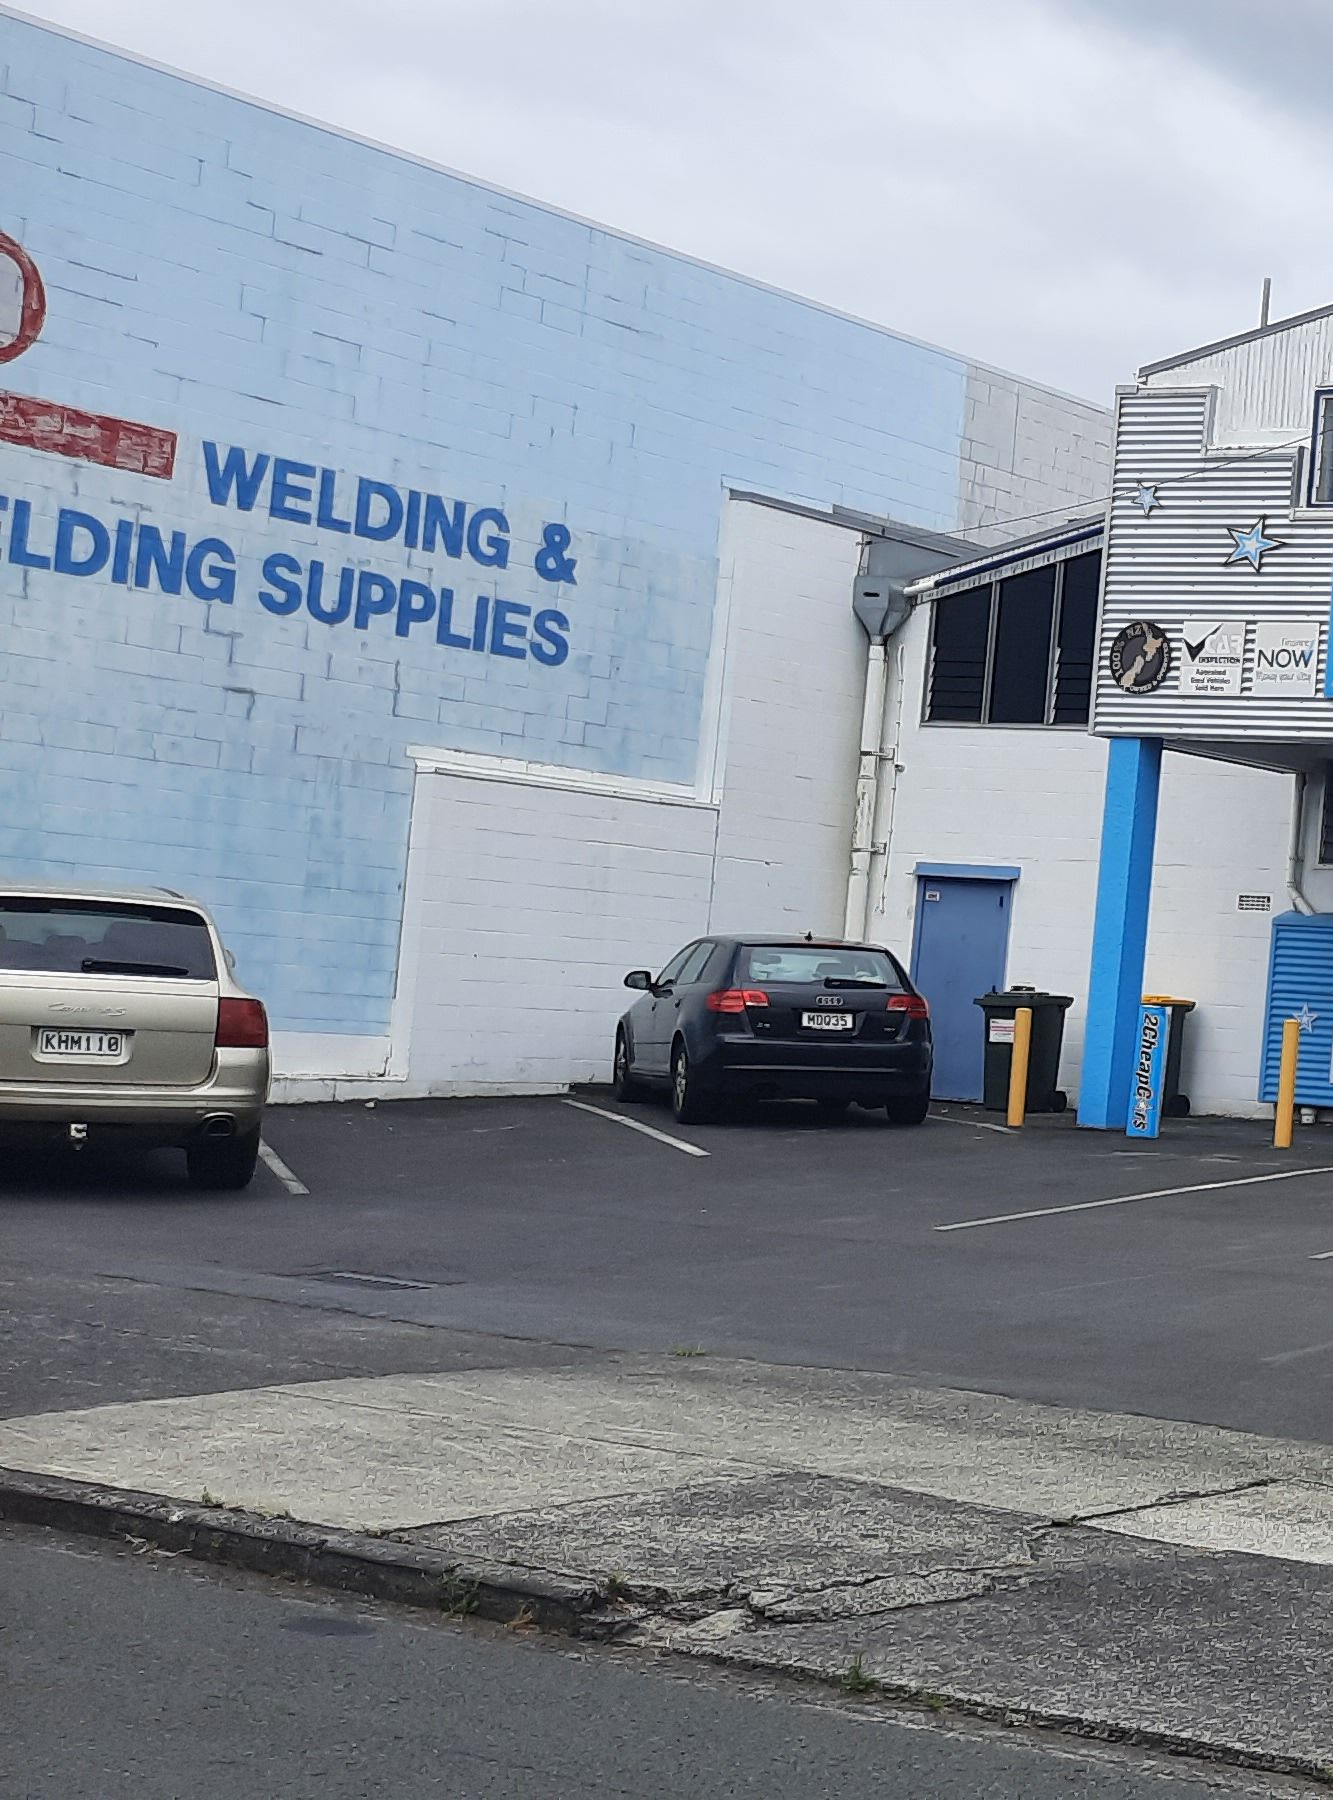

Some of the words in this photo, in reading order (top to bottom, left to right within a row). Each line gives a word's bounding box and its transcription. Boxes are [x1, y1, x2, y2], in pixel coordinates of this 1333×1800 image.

[201, 440, 512, 570] WELDING
[534, 522, 579, 586] &
[0, 494, 237, 605] LDING
[257, 552, 571, 667] SUPPLIES
[1257, 648, 1314, 669] NOW
[807, 1015, 848, 1027] MDQ35
[45, 1033, 119, 1052] KHM110
